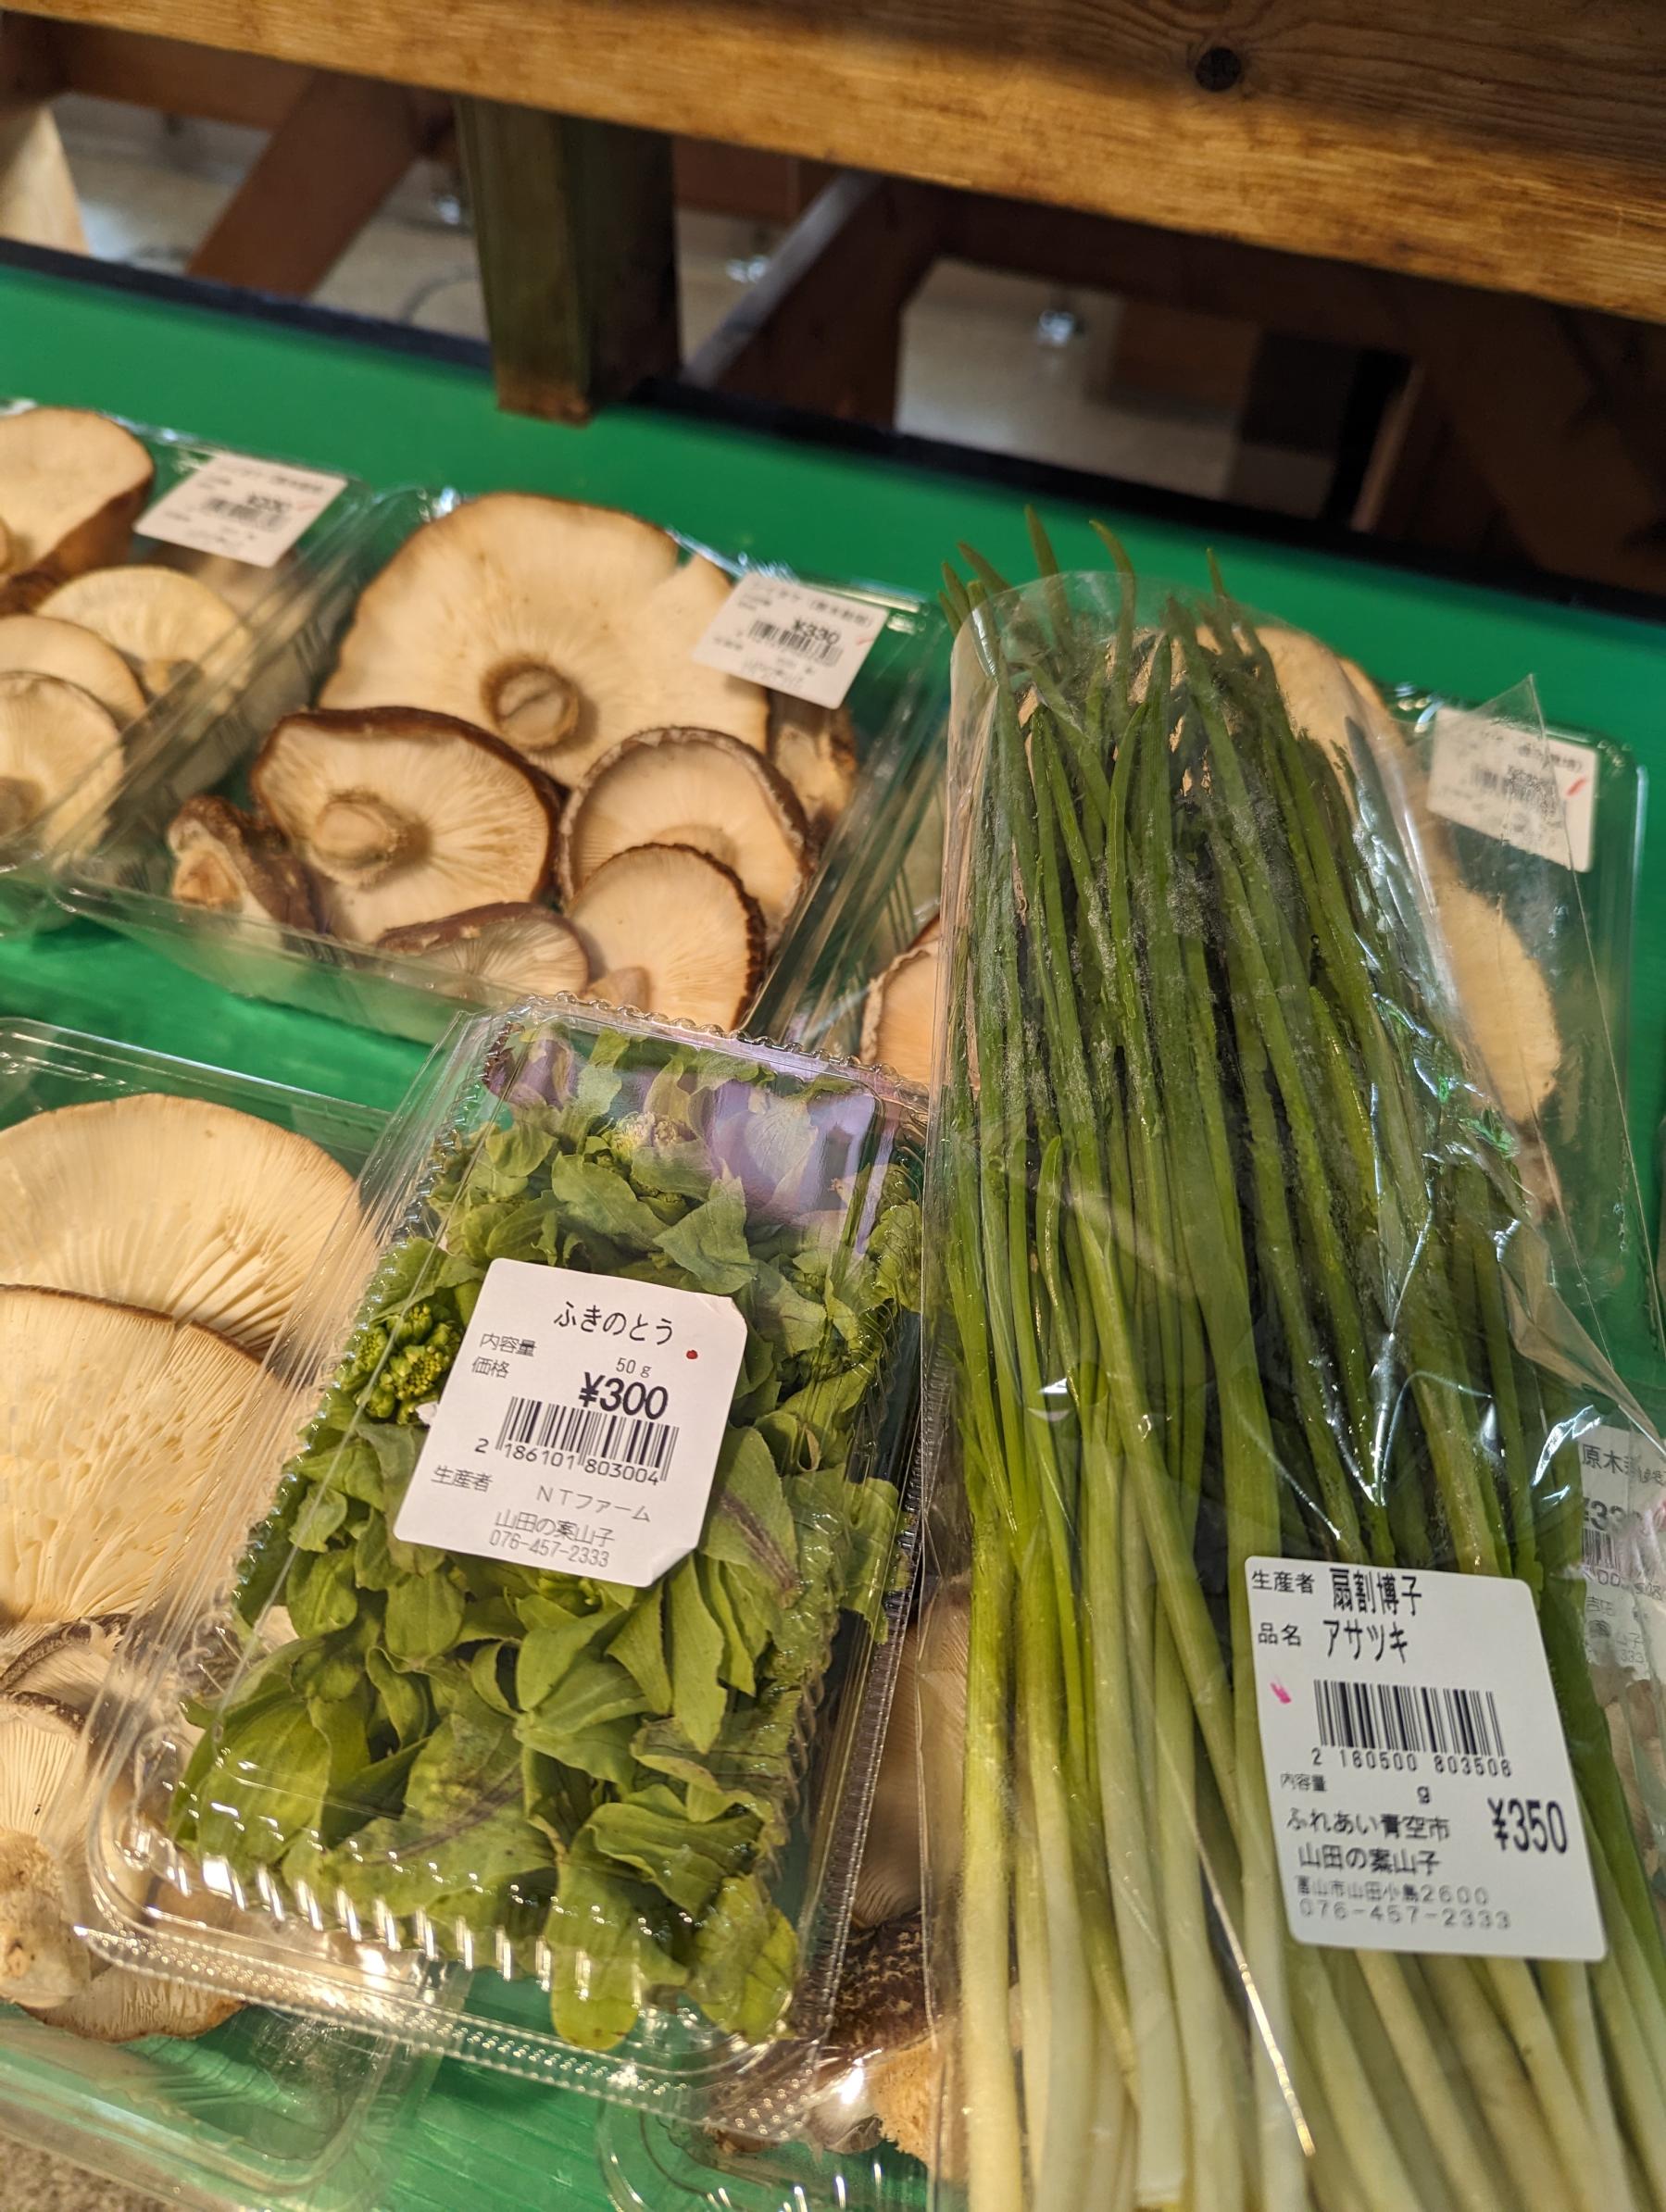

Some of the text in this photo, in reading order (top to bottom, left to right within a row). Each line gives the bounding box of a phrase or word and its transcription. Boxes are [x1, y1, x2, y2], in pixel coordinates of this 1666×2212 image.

[553, 1301, 674, 1345] ふきのとう
[479, 1333, 537, 1358] 内容量
[471, 1356, 509, 1379] 価格
[579, 1371, 670, 1420] ¥300
[431, 1465, 494, 1493] 生産者
[474, 1438, 660, 1487] 2 186101 803004
[489, 1529, 610, 1568] 076-457-2333
[1251, 1568, 1422, 1617] 生産者 扇割博子
[1257, 1618, 1409, 1664] 品名 アサツキ
[1311, 1748, 1322, 1765] 2
[1280, 1774, 1328, 1793] 内容量
[1286, 1807, 1451, 1842] ふれあい青空市
[1486, 1797, 1568, 1854] ¥350
[1298, 1897, 1512, 1931] 076-457-2333
